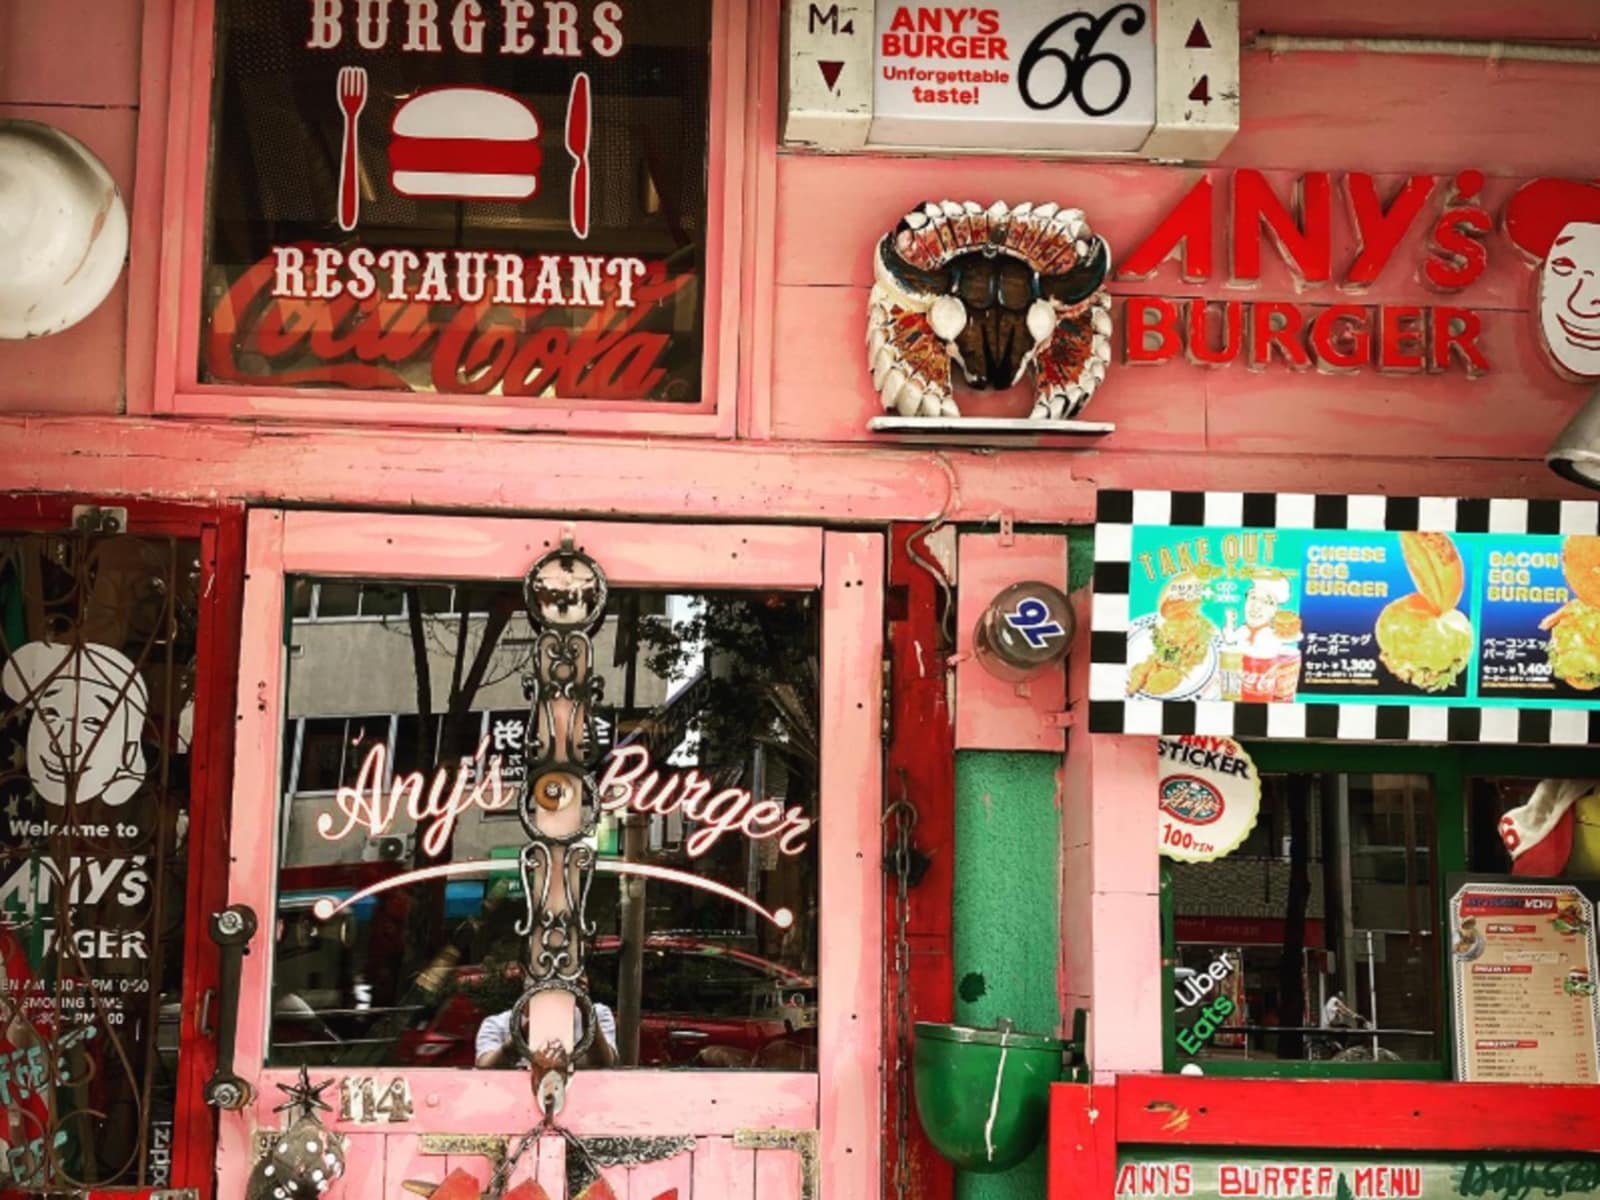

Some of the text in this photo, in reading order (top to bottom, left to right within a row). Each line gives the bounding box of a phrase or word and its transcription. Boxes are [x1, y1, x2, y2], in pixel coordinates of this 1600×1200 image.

[306, 0, 625, 56] BURGERS
[889, 6, 1000, 33] ANY'S
[881, 33, 1009, 60] BURGER
[1017, 2, 1146, 117] 66
[882, 66, 1010, 84] Unforgettable
[912, 85, 980, 105] taste!
[271, 246, 647, 308] RESTAURANT
[1120, 297, 1491, 380] BURGER
[1138, 531, 1278, 582] TAKE OUT
[1306, 545, 1388, 563] CHEESE
[1489, 551, 1560, 568] BACON
[1306, 563, 1350, 580] EGG
[1488, 568, 1532, 585] EGG
[1305, 579, 1390, 598] BURGER
[1487, 585, 1570, 603] BURGER
[1157, 739, 1251, 780] STICKER
[317, 730, 814, 858] Any's Burger
[116, 822, 139, 837] to
[1163, 822, 1193, 849] 100
[1174, 952, 1234, 1006] Uber
[1176, 994, 1235, 1055] Eats
[1354, 1166, 1422, 1198] MENU
